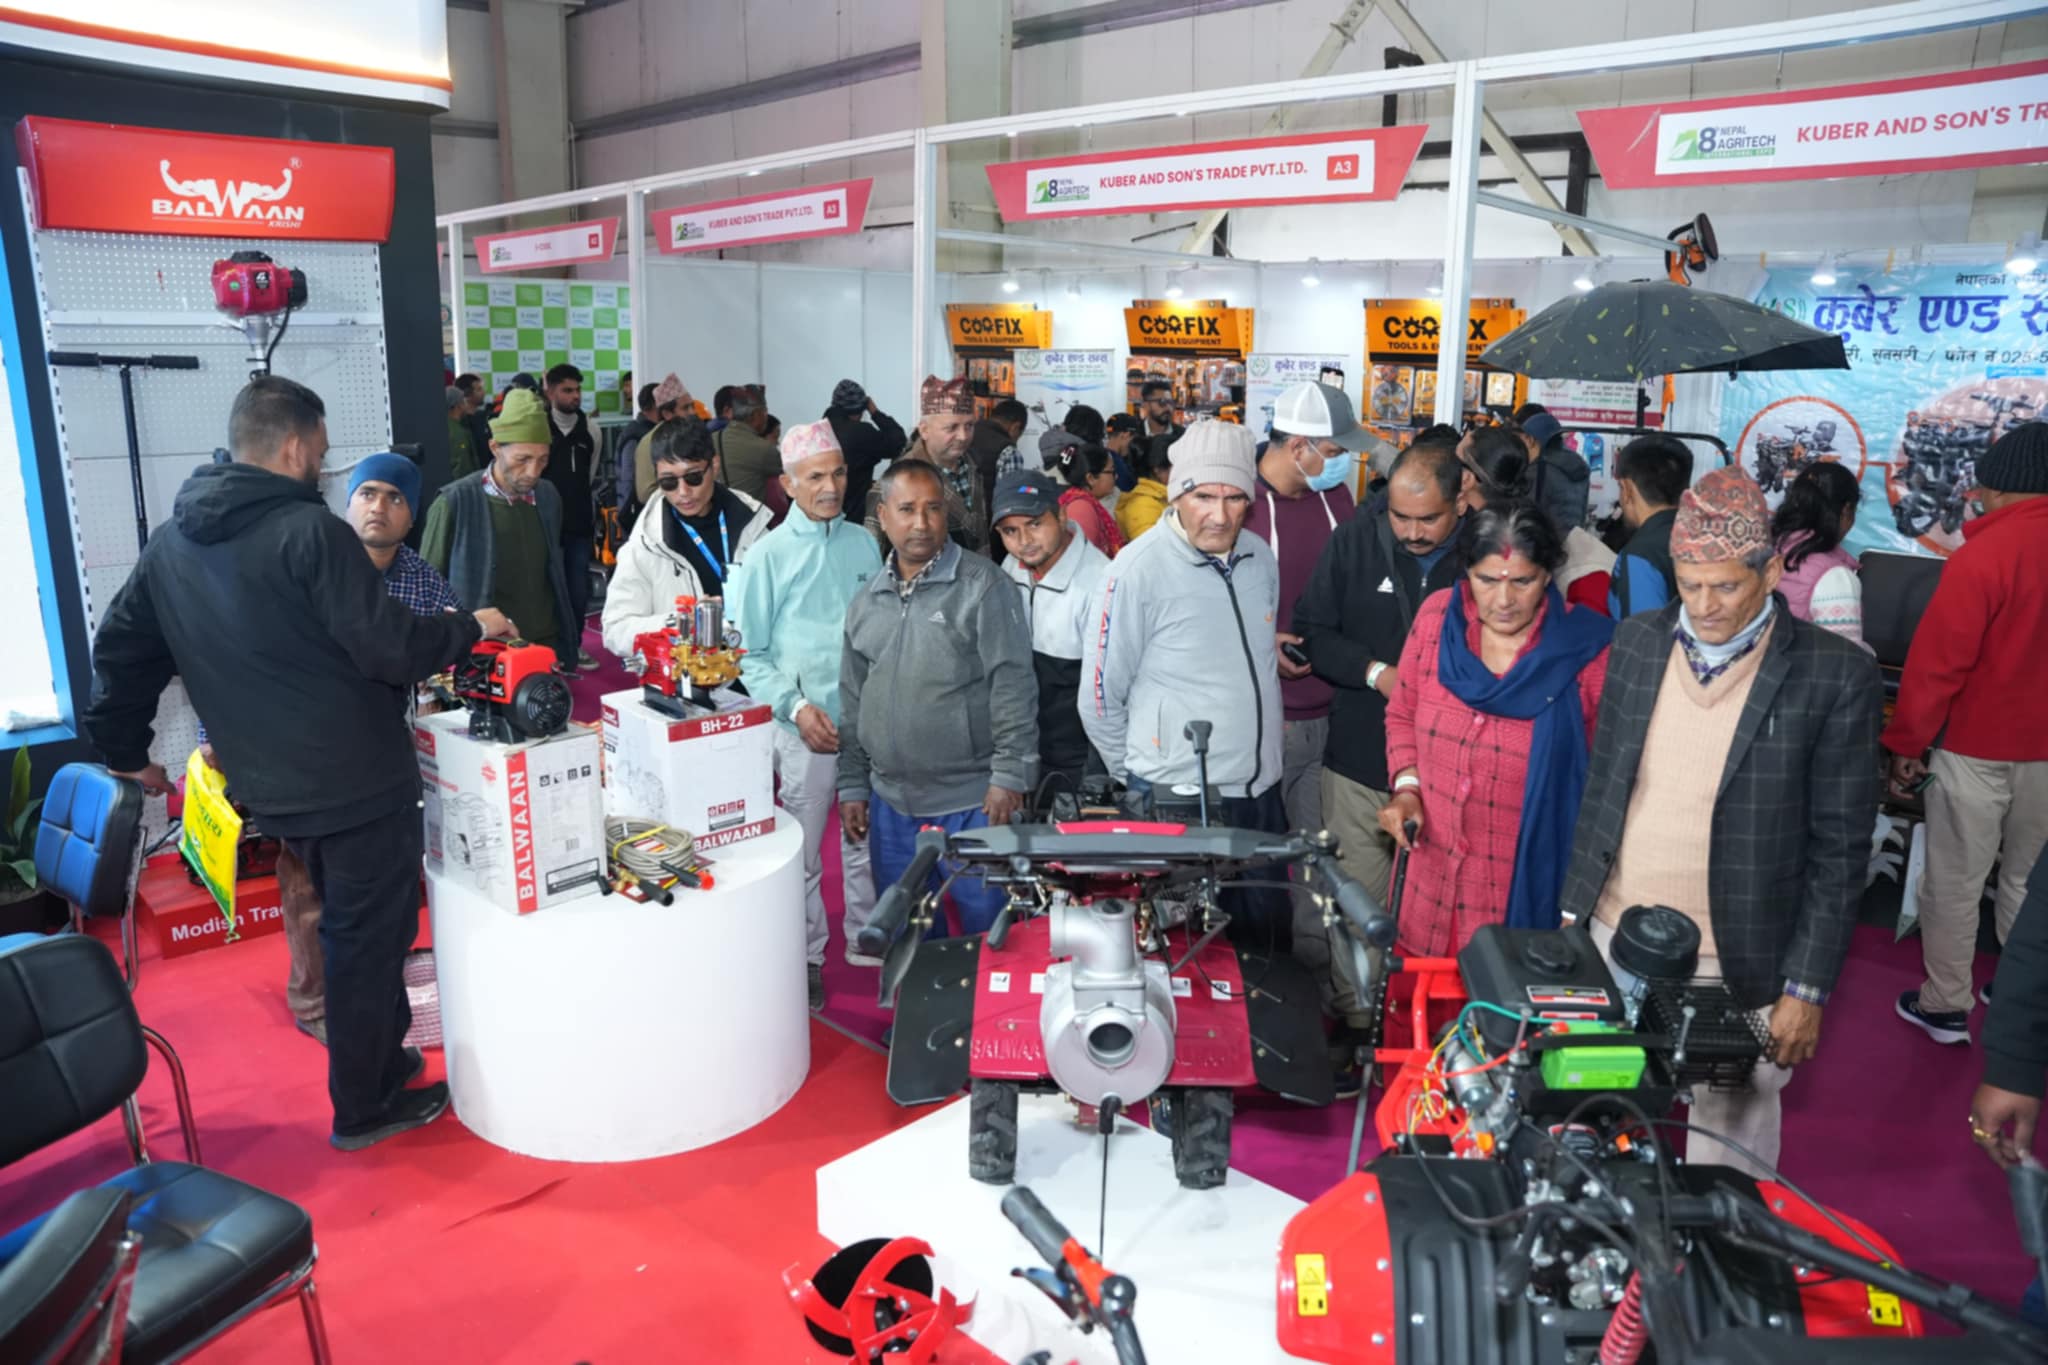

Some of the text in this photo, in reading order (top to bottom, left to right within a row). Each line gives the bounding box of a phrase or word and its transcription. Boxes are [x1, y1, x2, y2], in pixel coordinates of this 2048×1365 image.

[1720, 125, 1748, 135] NEPAL
[1796, 121, 1869, 143] KUBER
[1874, 115, 1927, 137] AND
[1933, 105, 2011, 132] SON'S
[1717, 134, 1777, 150] AGRITECH
[1099, 175, 1137, 189] KUBER
[1139, 171, 1166, 185] AND
[1167, 168, 1204, 183] SON'S
[1207, 165, 1248, 181] TRADE
[1333, 160, 1352, 175] A3
[152, 178, 305, 221] BALWAAN
[729, 215, 743, 227] AND
[763, 210, 784, 222] TRADE
[1138, 314, 1220, 336] COOFIX
[1918, 295, 2009, 334] एण्ड
[960, 316, 1023, 335] COOFIX
[1384, 316, 1488, 341] COOX
[1143, 336, 1167, 344] TOOLS
[1177, 337, 1222, 346] EQUIPMENT
[1387, 341, 1418, 350] TOOLS
[1421, 342, 1428, 350] &
[701, 713, 745, 734] BH-22
[510, 770, 534, 900] BALWAAN
